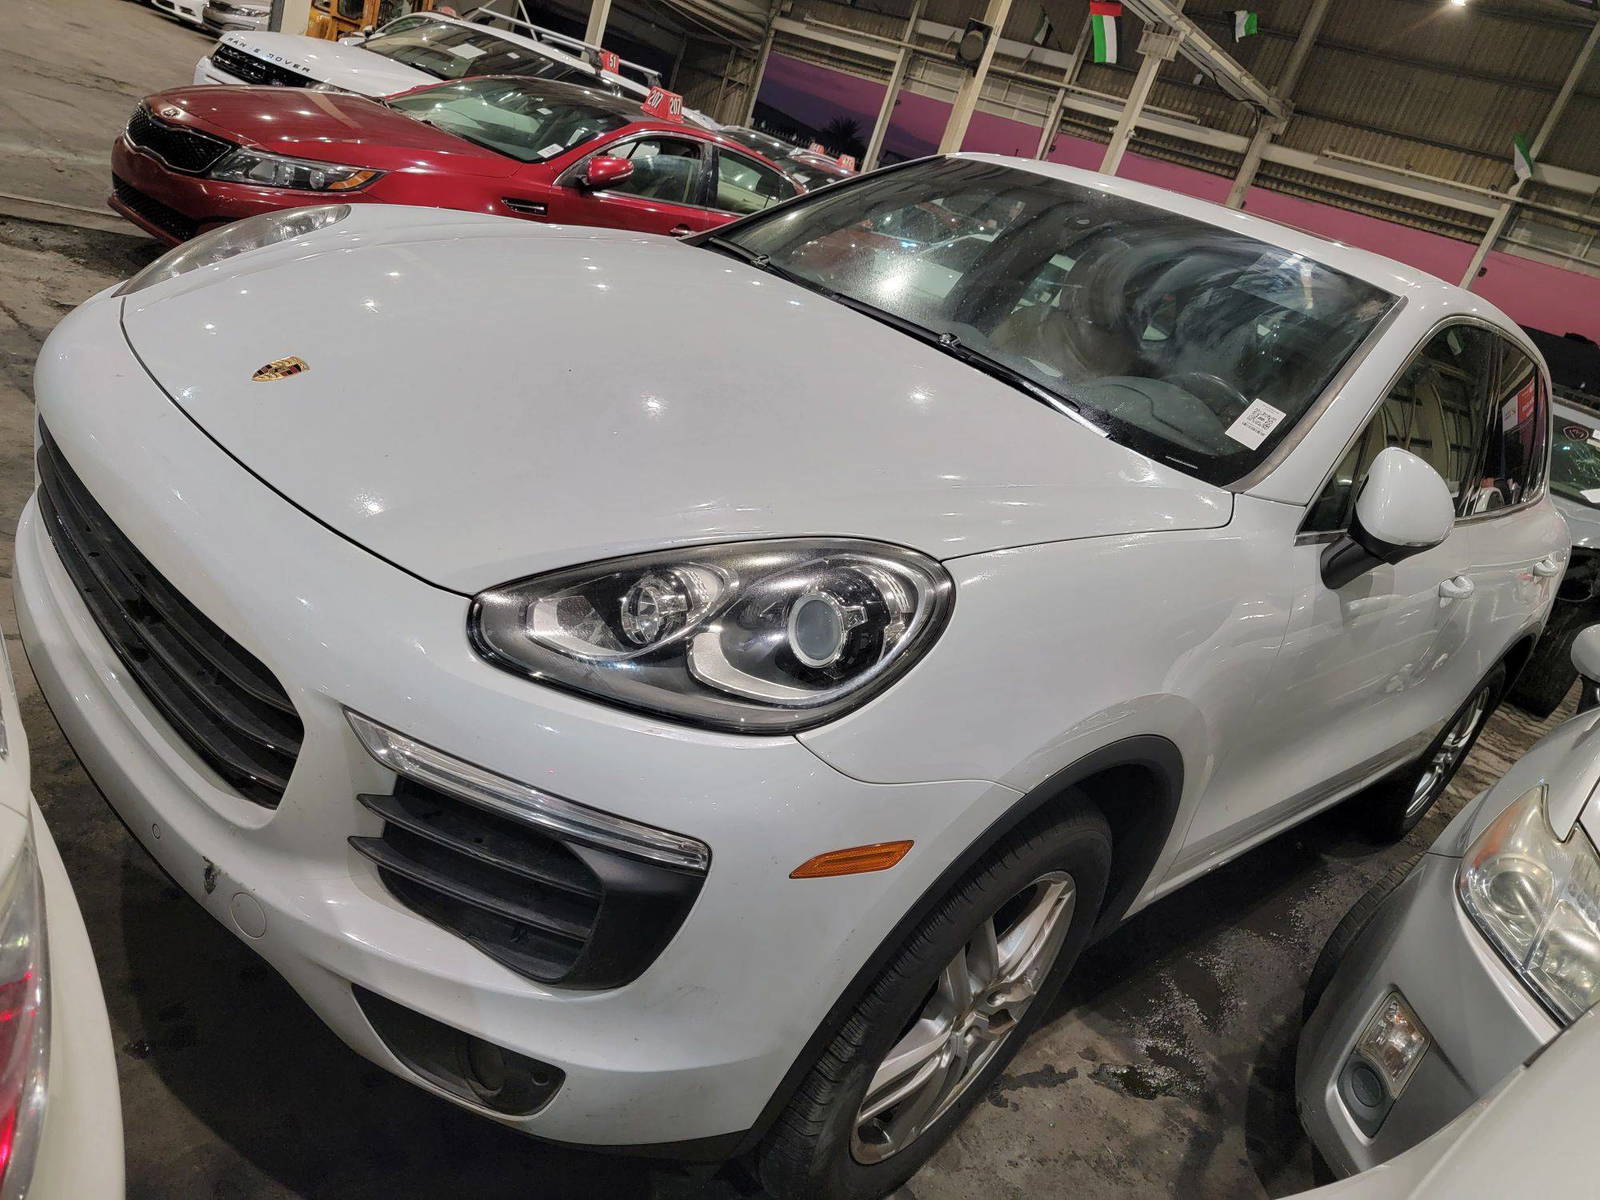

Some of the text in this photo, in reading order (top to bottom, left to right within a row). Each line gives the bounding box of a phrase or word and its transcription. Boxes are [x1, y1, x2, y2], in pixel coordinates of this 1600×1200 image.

[227, 37, 261, 53] RANE
[609, 54, 616, 68] 51
[648, 89, 664, 108] 207
[670, 97, 681, 115] 207
